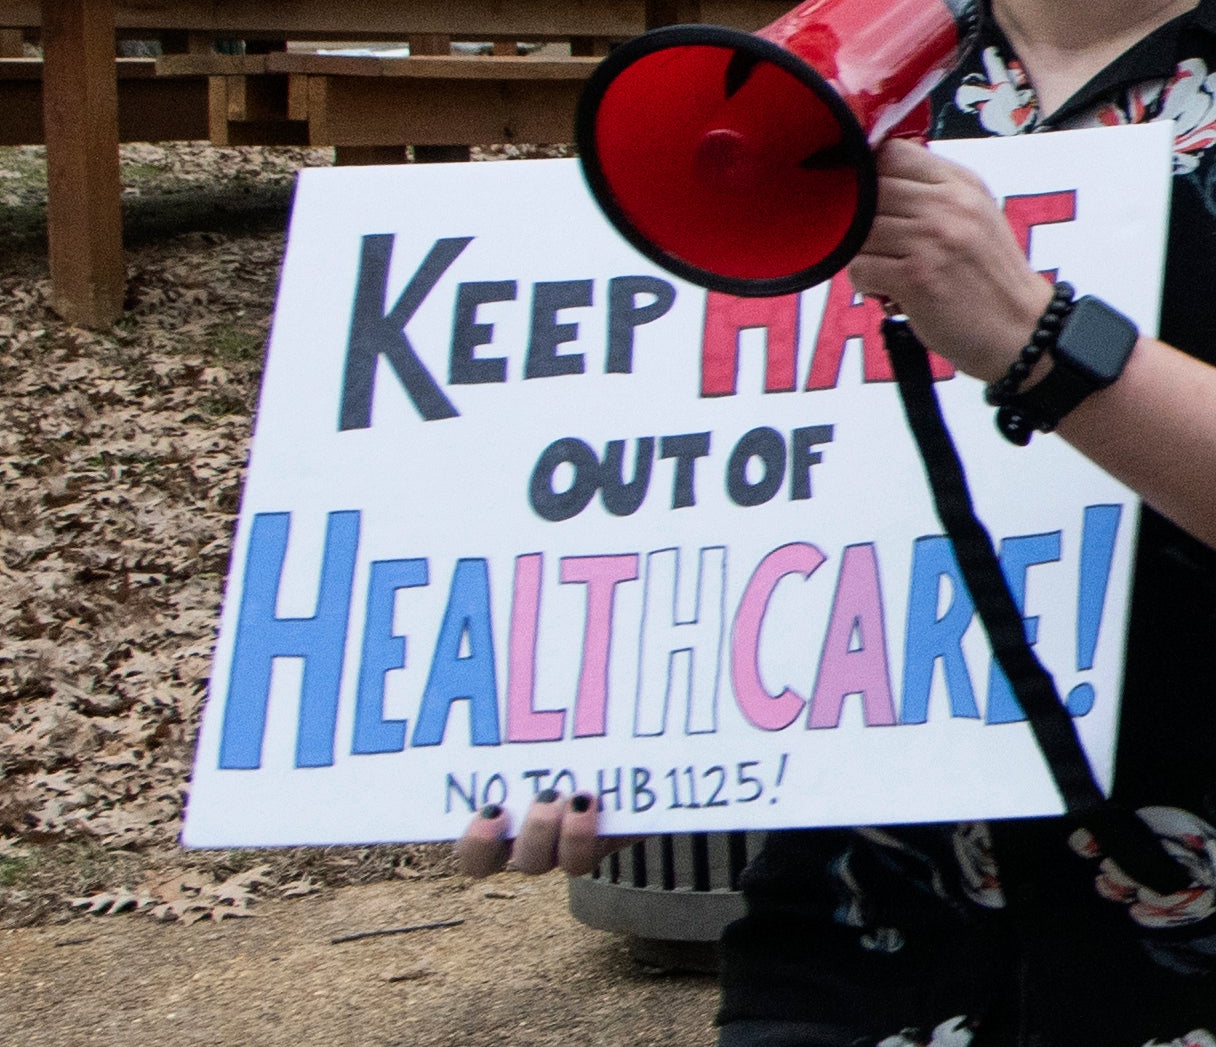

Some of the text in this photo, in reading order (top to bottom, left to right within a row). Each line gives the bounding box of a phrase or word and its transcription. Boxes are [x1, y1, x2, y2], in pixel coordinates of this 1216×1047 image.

[337, 232, 677, 432] KEEP
[528, 423, 837, 521] OUT OF
[445, 770, 507, 813] NO
